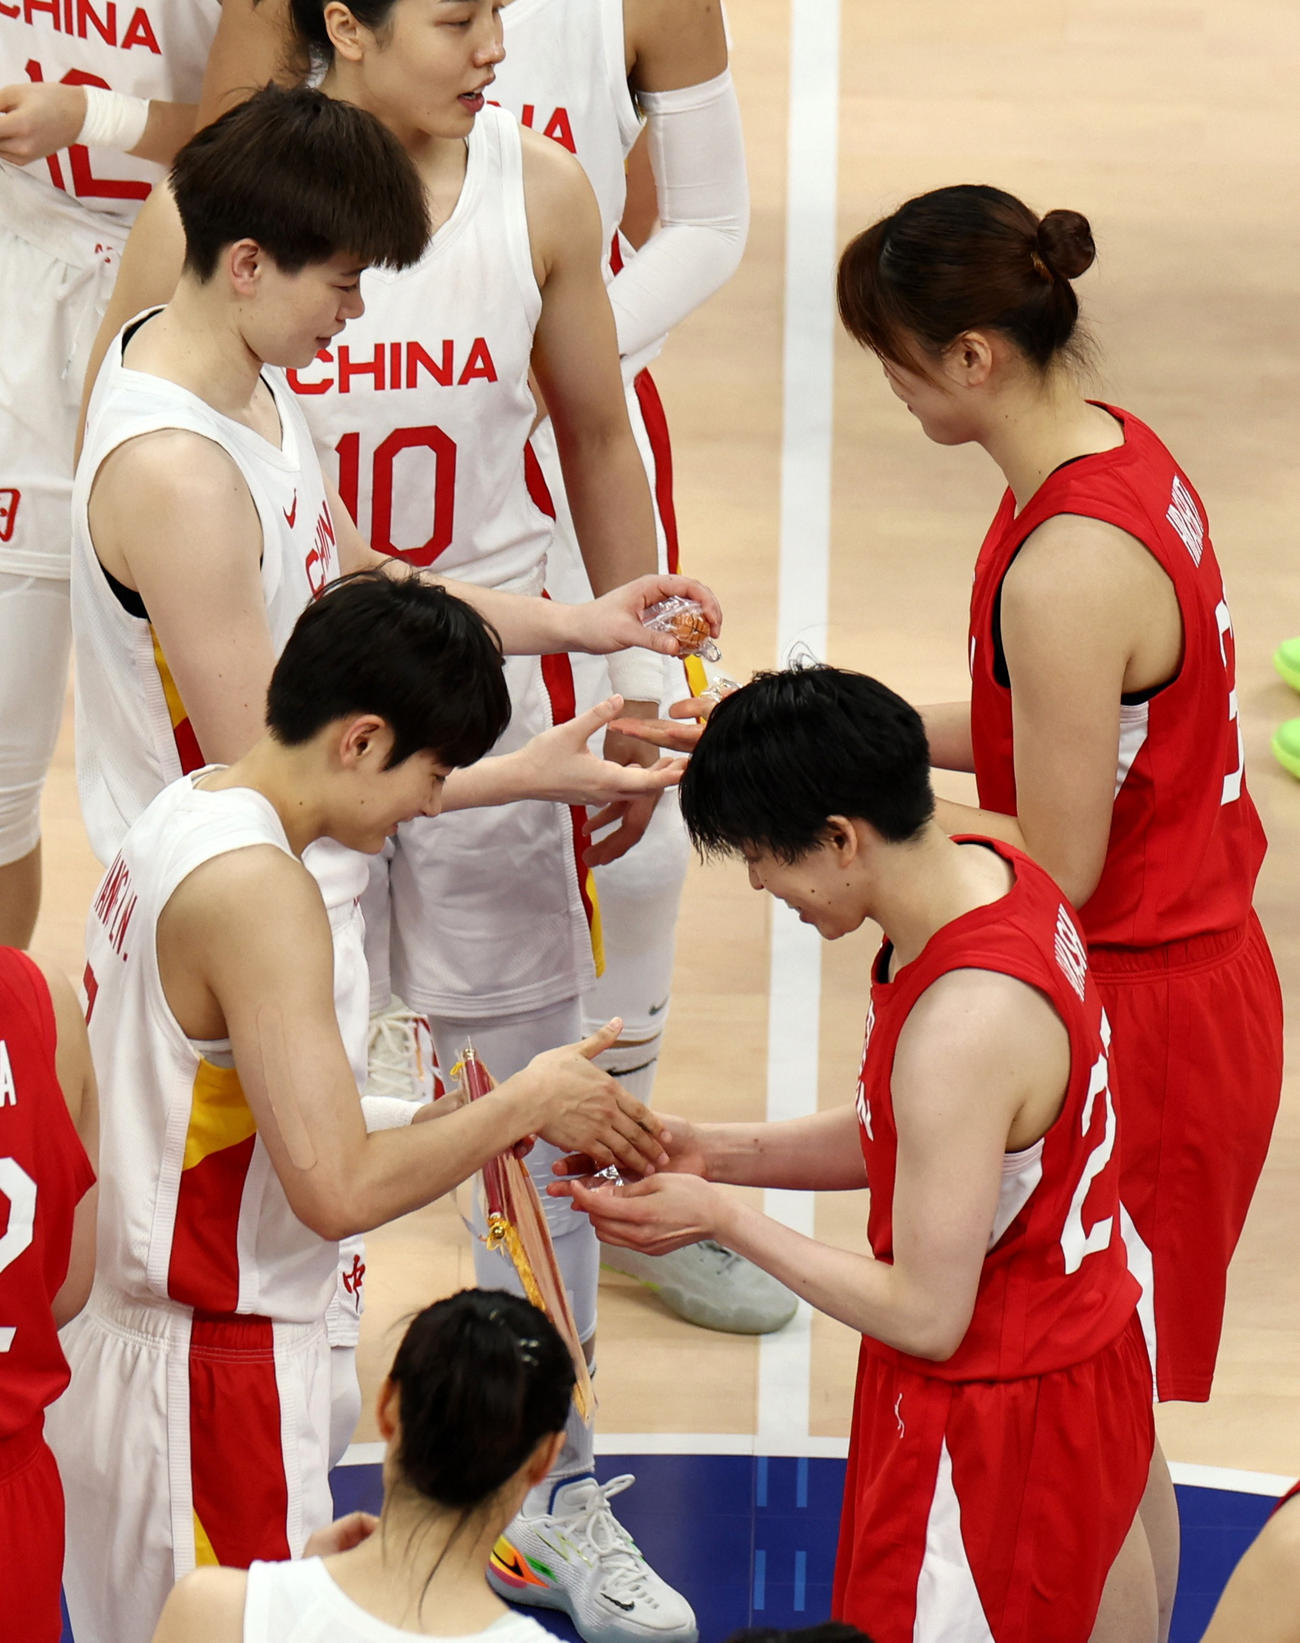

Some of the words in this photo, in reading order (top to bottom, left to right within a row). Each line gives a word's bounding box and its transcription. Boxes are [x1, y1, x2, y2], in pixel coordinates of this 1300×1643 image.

[0, 0, 162, 55] HINA
[285, 337, 498, 395] CHINA
[335, 425, 457, 567] 10
